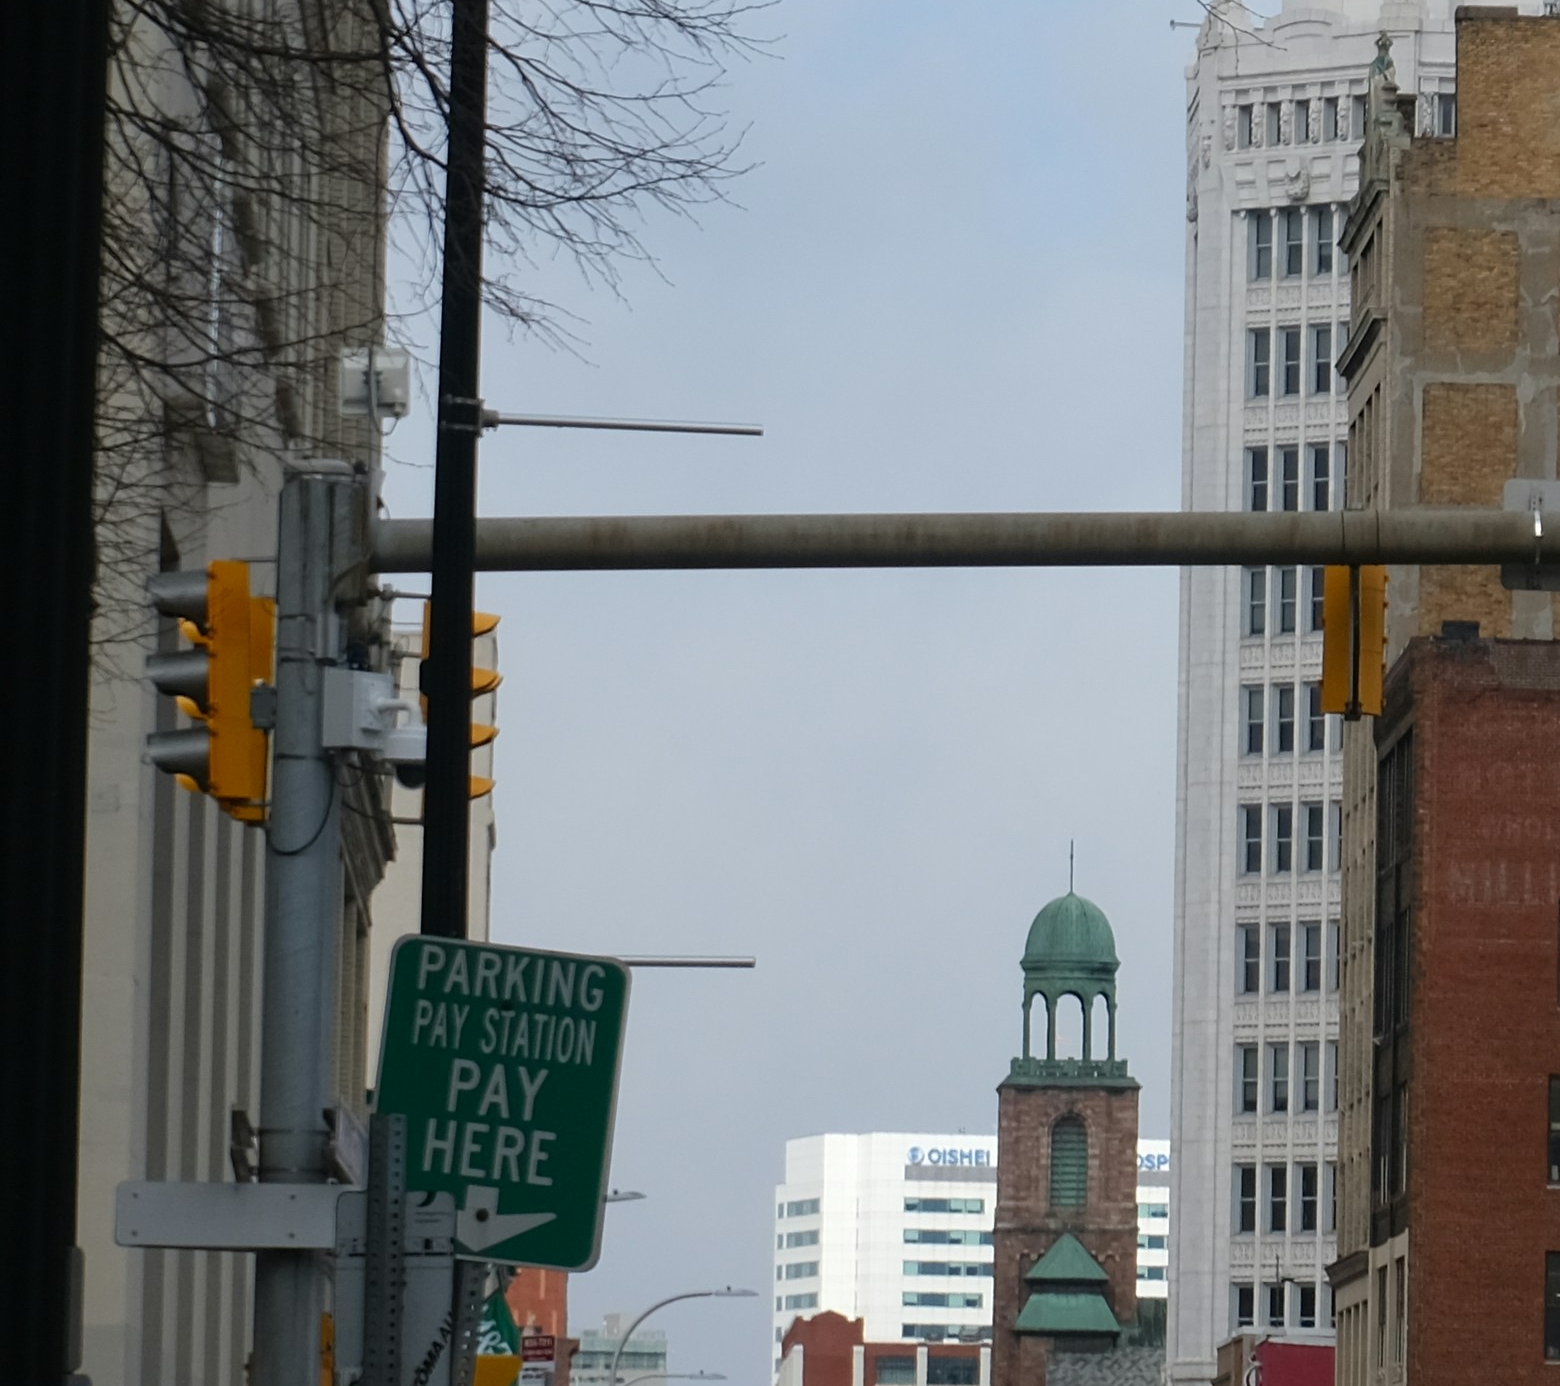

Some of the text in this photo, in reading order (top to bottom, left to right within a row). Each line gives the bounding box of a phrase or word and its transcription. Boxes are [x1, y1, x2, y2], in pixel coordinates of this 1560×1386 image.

[417, 944, 606, 1011] PARKING
[411, 999, 597, 1065] PAY STATION
[448, 1058, 549, 1121] PAY
[422, 1118, 557, 1186] HERE
[928, 1148, 990, 1165] OISHEI
